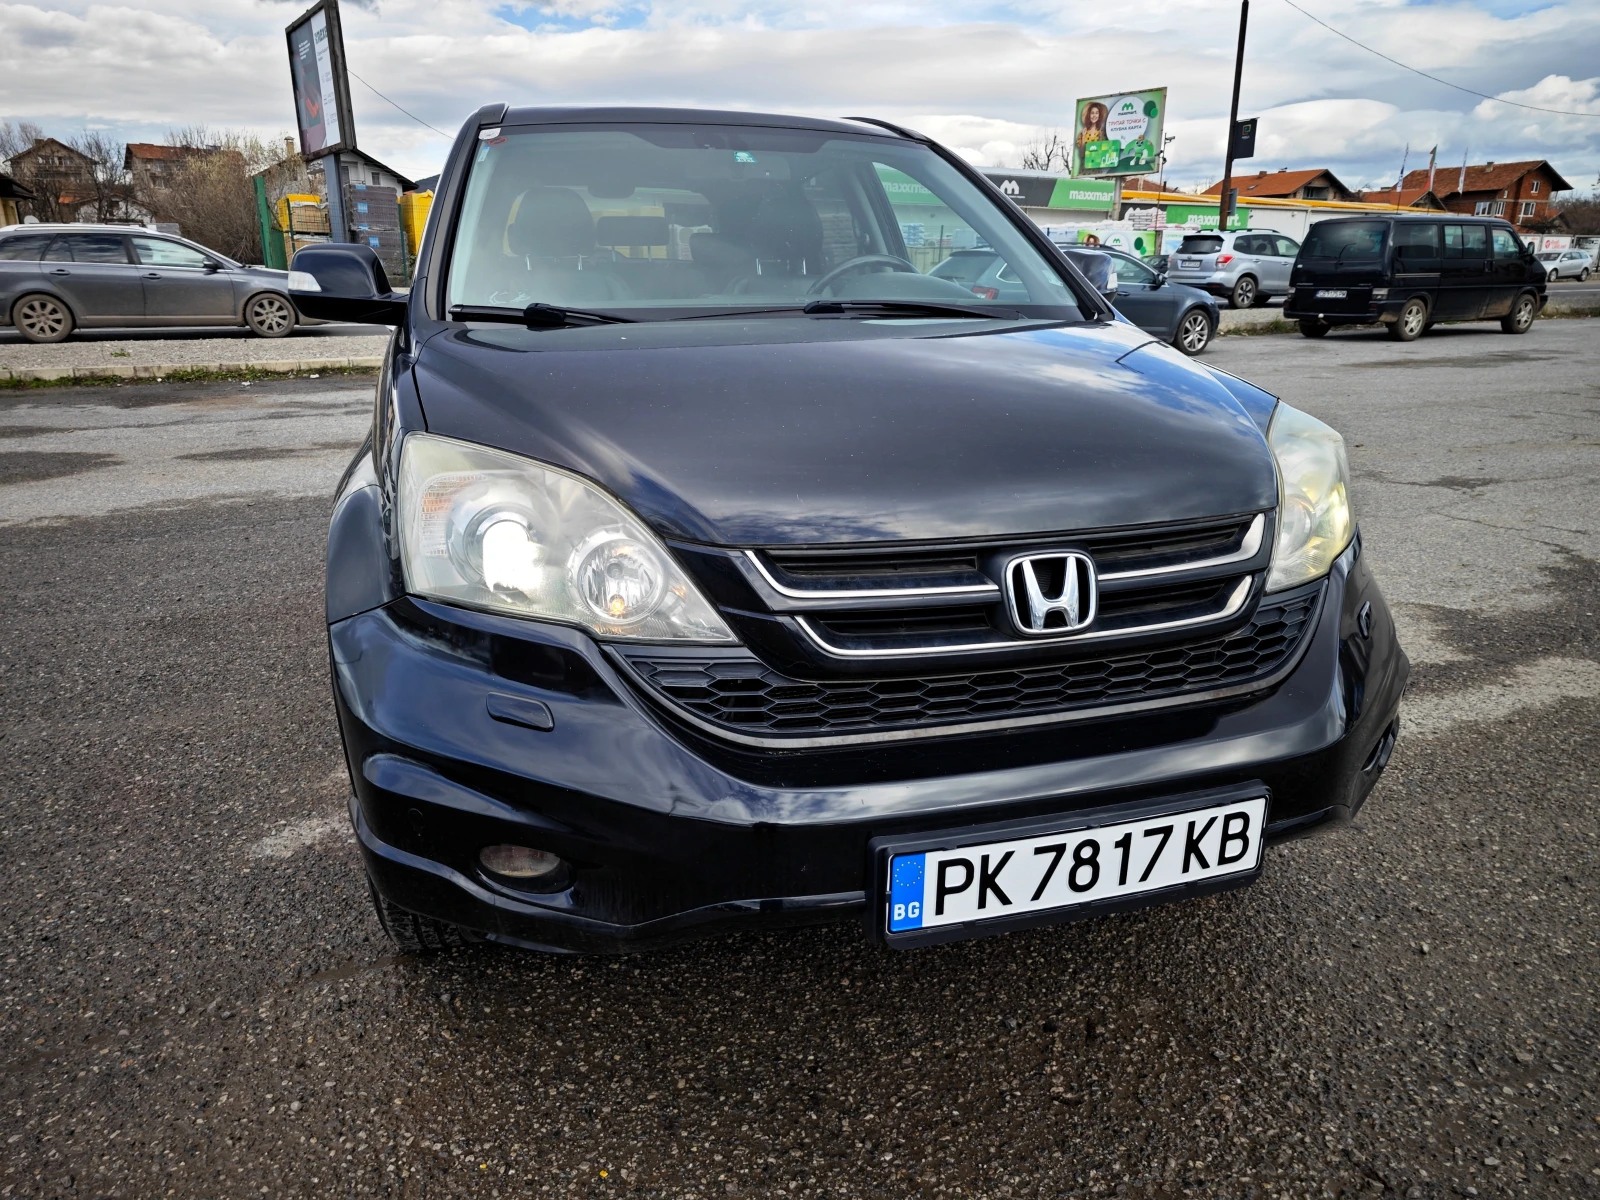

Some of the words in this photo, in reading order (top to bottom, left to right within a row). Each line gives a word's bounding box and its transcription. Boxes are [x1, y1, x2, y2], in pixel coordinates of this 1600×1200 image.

[882, 181, 932, 194] maxxma
[1187, 214, 1242, 226] maxxmrt.
[934, 850, 1016, 916] PK
[1030, 824, 1175, 902] 7817
[1181, 810, 1250, 874] KB
[893, 901, 921, 921] BG
